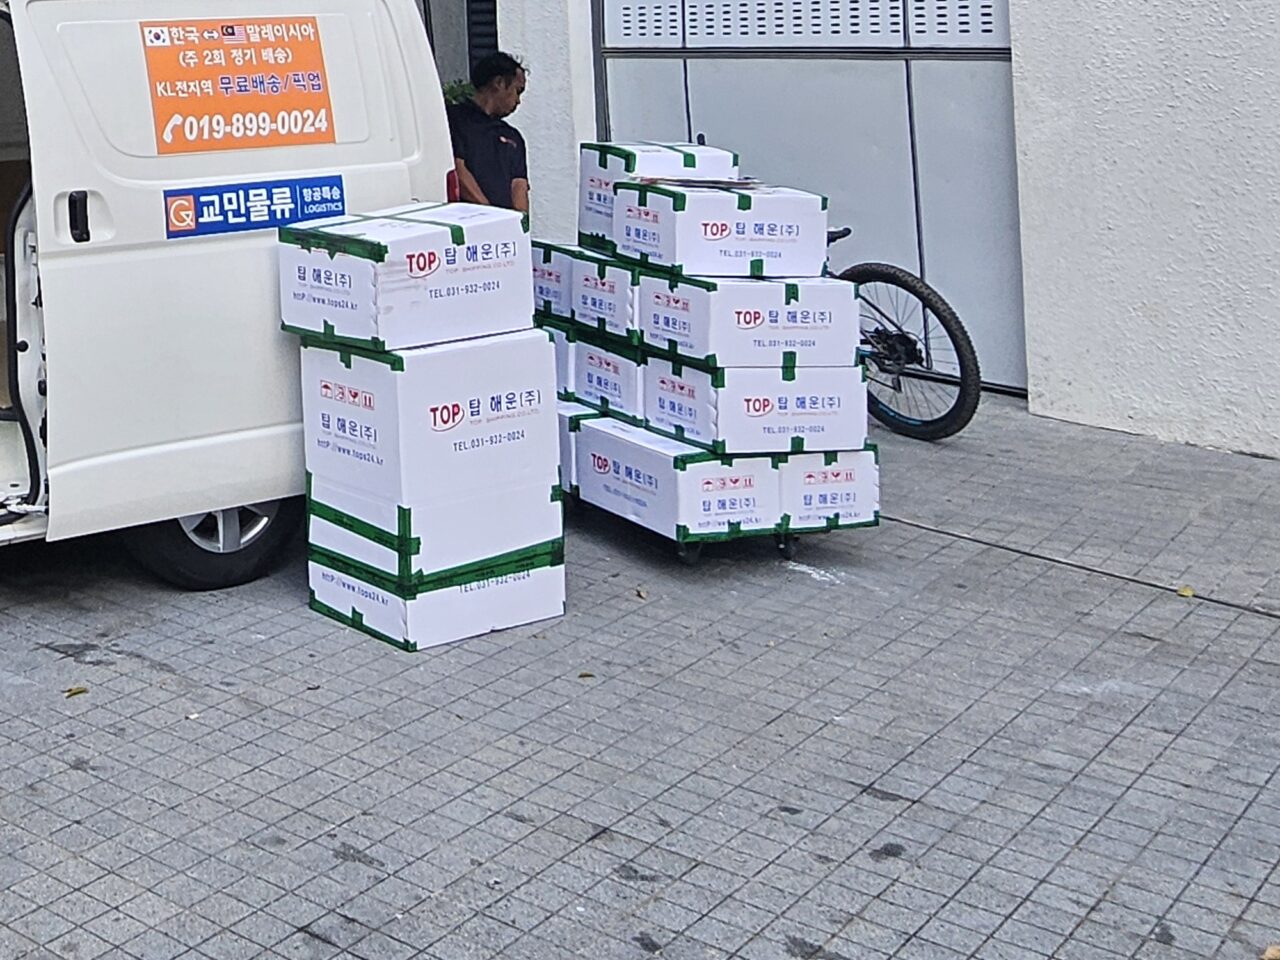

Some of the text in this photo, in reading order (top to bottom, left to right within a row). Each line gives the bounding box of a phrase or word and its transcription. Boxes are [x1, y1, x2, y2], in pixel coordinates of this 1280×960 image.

[170, 23, 315, 45] 한국 말레이시아
[178, 47, 293, 67] (주 2회 정기 배송)
[156, 80, 213, 97] KL전지역
[184, 108, 328, 140] 019-899-0024
[197, 187, 295, 224] 교민물류
[304, 202, 343, 214] LOGISTICS
[701, 222, 728, 237] TOP
[753, 222, 800, 237] 해운(주)
[406, 241, 516, 273] TOP 탑 해운(주)
[312, 268, 352, 289] 해운(주)
[428, 280, 500, 299] TEL.031-932-0024
[735, 310, 761, 325] TOP
[786, 310, 832, 325] 해운(주)
[430, 389, 541, 427] TOP 탑 해운(주)
[743, 397, 770, 413] TOP
[795, 395, 842, 410] 해운(주)
[336, 416, 377, 444] 해운(주)
[453, 429, 525, 452] TEL.031-932-0024
[590, 452, 609, 472] TOP
